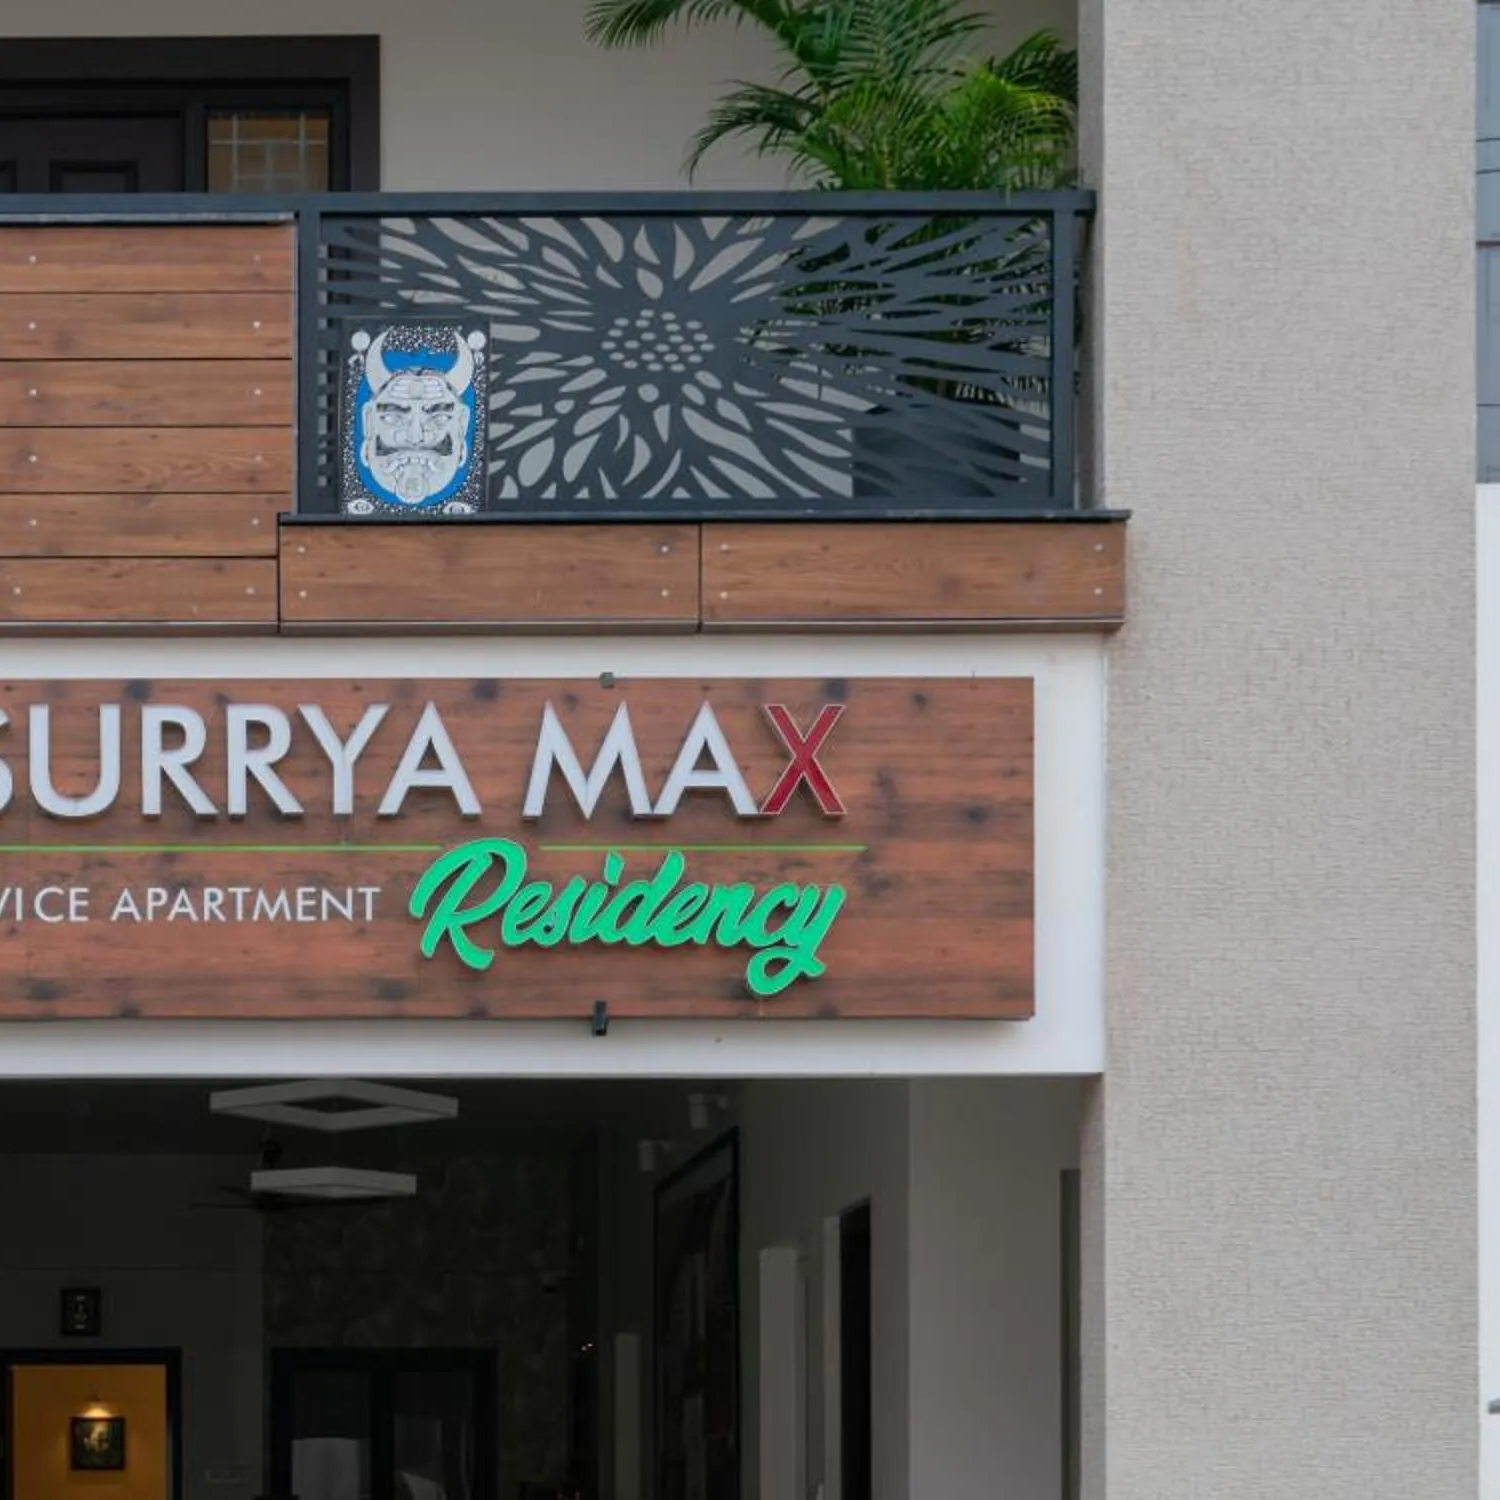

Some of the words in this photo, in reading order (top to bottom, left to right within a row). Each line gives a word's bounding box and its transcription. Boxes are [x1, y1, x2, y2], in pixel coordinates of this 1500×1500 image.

[522, 701, 847, 819] MAX
[109, 886, 381, 923] APARTMENT
[408, 837, 847, 997] Residency
